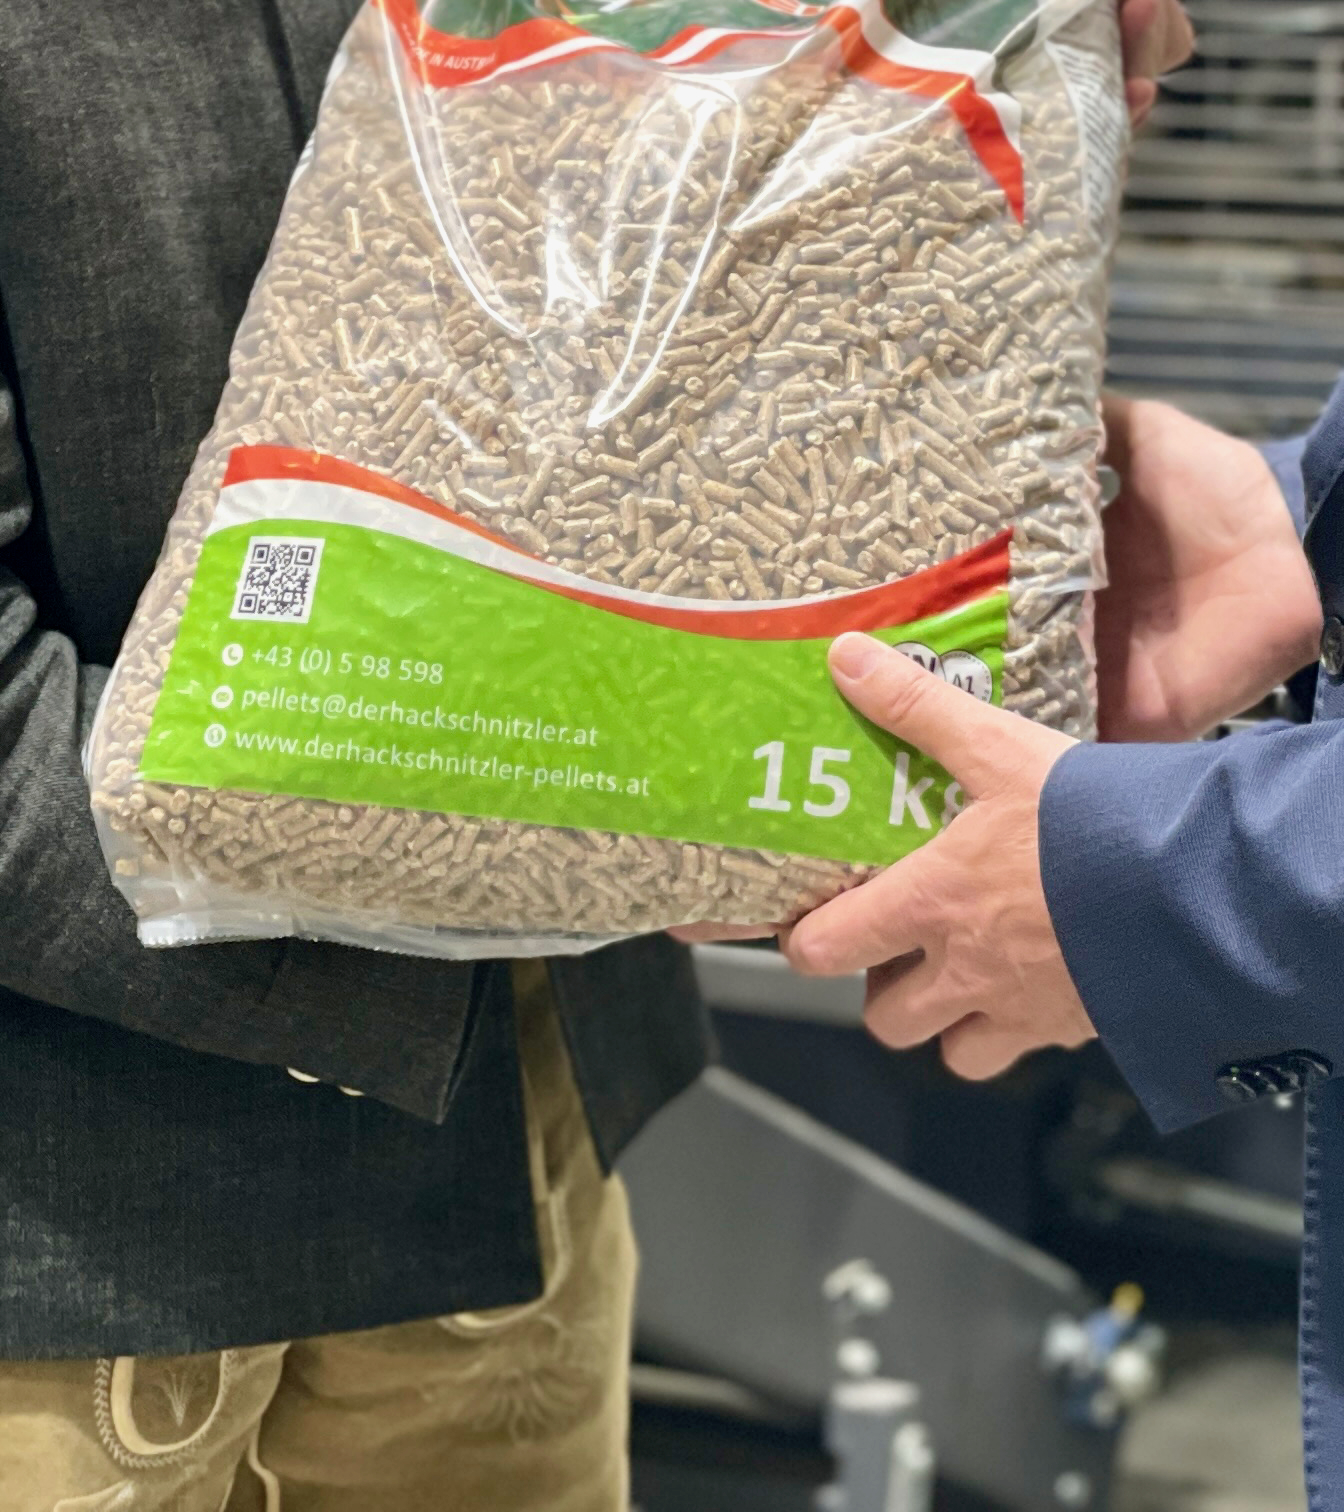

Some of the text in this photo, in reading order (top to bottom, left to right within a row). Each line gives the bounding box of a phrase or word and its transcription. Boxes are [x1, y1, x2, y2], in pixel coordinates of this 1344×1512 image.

[252, 645, 444, 685] +43 (0) 5 98 598
[242, 687, 598, 747] pellets@derhackschnitzler.at
[236, 731, 651, 797] www.derhackschnitzler-pellets.at
[748, 741, 851, 818] 15
